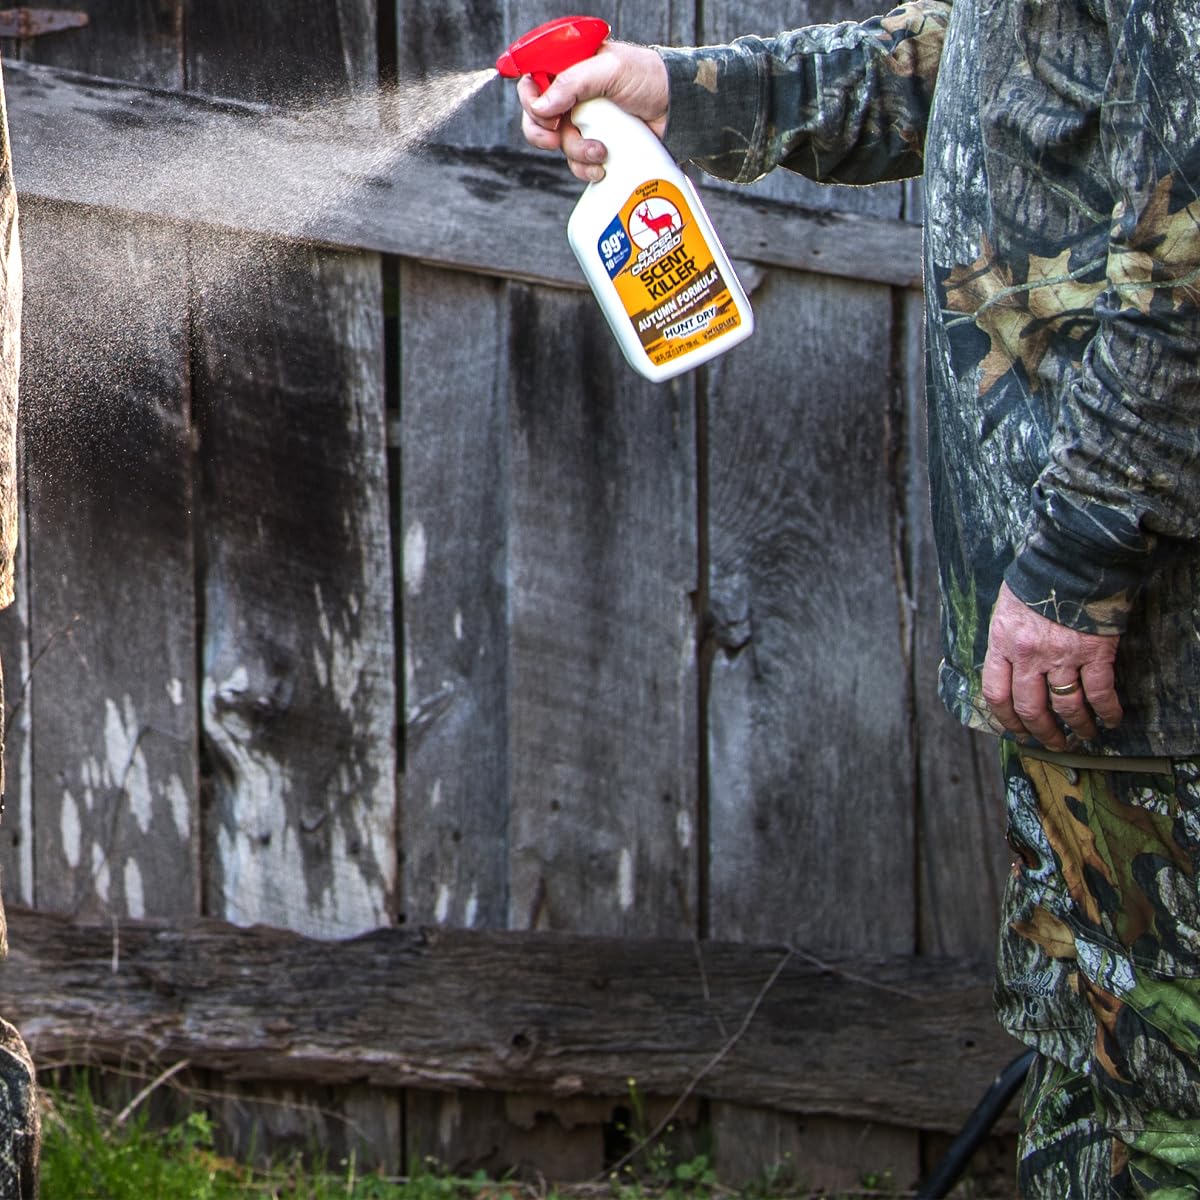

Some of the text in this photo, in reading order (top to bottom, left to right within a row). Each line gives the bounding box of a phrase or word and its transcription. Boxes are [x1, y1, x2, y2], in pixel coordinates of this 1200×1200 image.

[601, 229, 625, 259] 99%
[631, 234, 681, 275] CHARGED
[638, 231, 672, 261] SUPER
[640, 243, 688, 288] SCENT
[647, 259, 698, 301] KILLER
[638, 299, 677, 333] AUTUMN
[676, 269, 719, 307] FORMULA
[664, 318, 695, 339] HUNT
[696, 307, 716, 324] DRY
